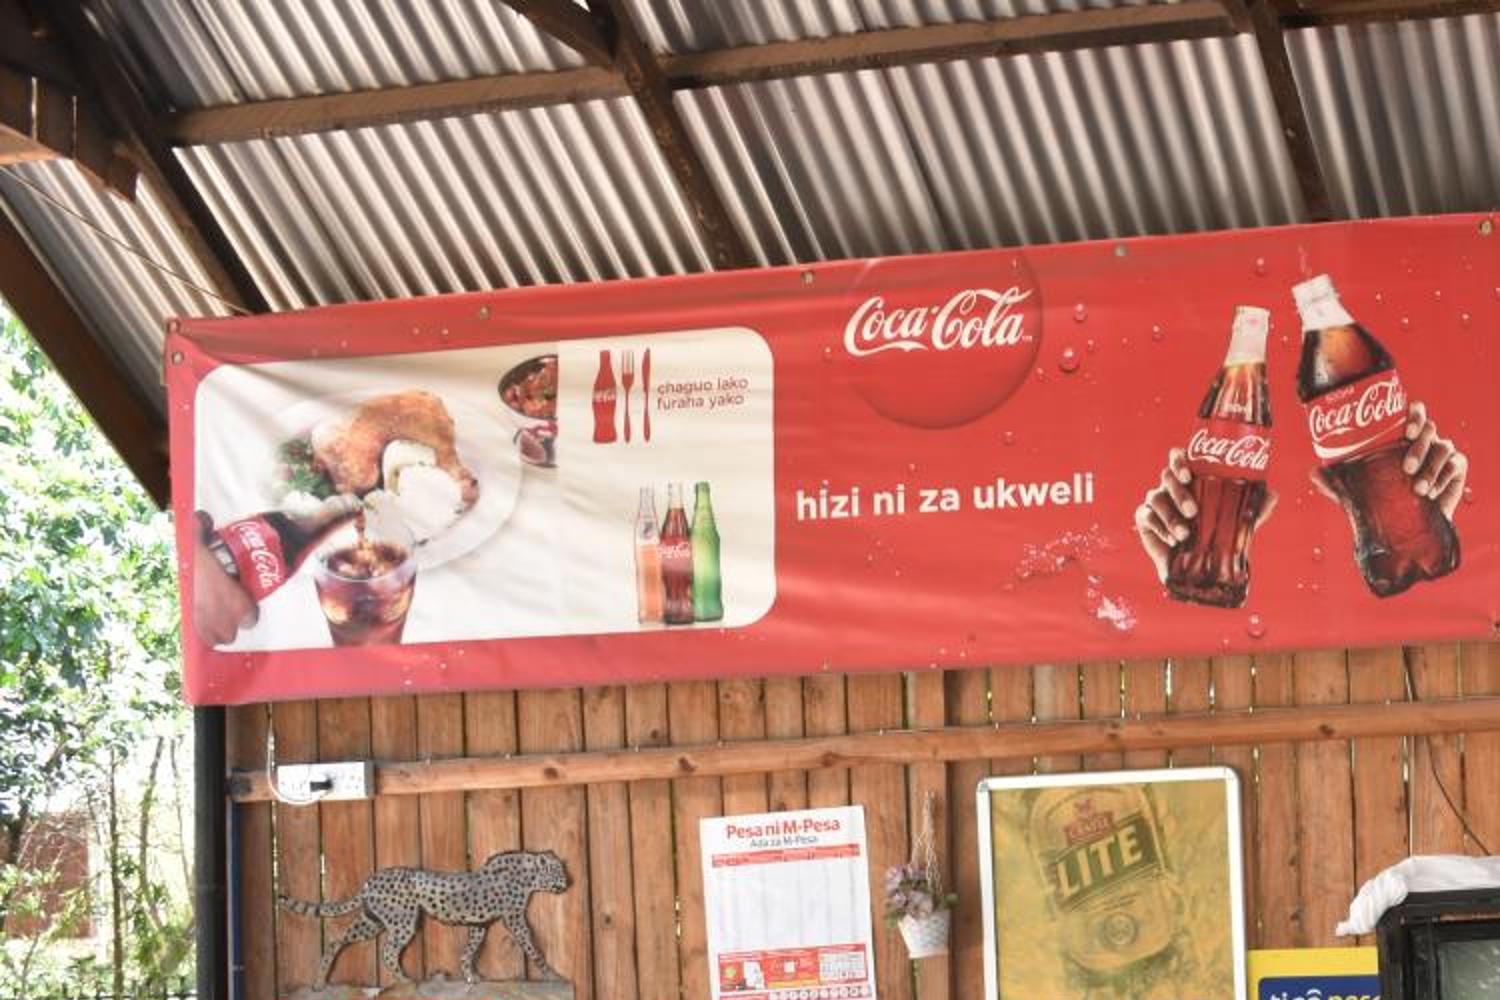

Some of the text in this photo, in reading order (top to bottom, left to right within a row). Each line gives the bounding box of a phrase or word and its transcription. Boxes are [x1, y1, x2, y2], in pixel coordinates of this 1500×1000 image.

[843, 286, 1034, 356] Coca-Cola
[657, 376, 749, 395] chaguo lako
[657, 393, 745, 411] furaha yako
[1309, 375, 1407, 442] Coca-Cola
[1187, 428, 1271, 471] Coca-Cola
[796, 472, 1094, 521] hizi ni za ukweli
[726, 818, 841, 839] Pesa ni M-Pesa
[1056, 824, 1143, 897] LITE
